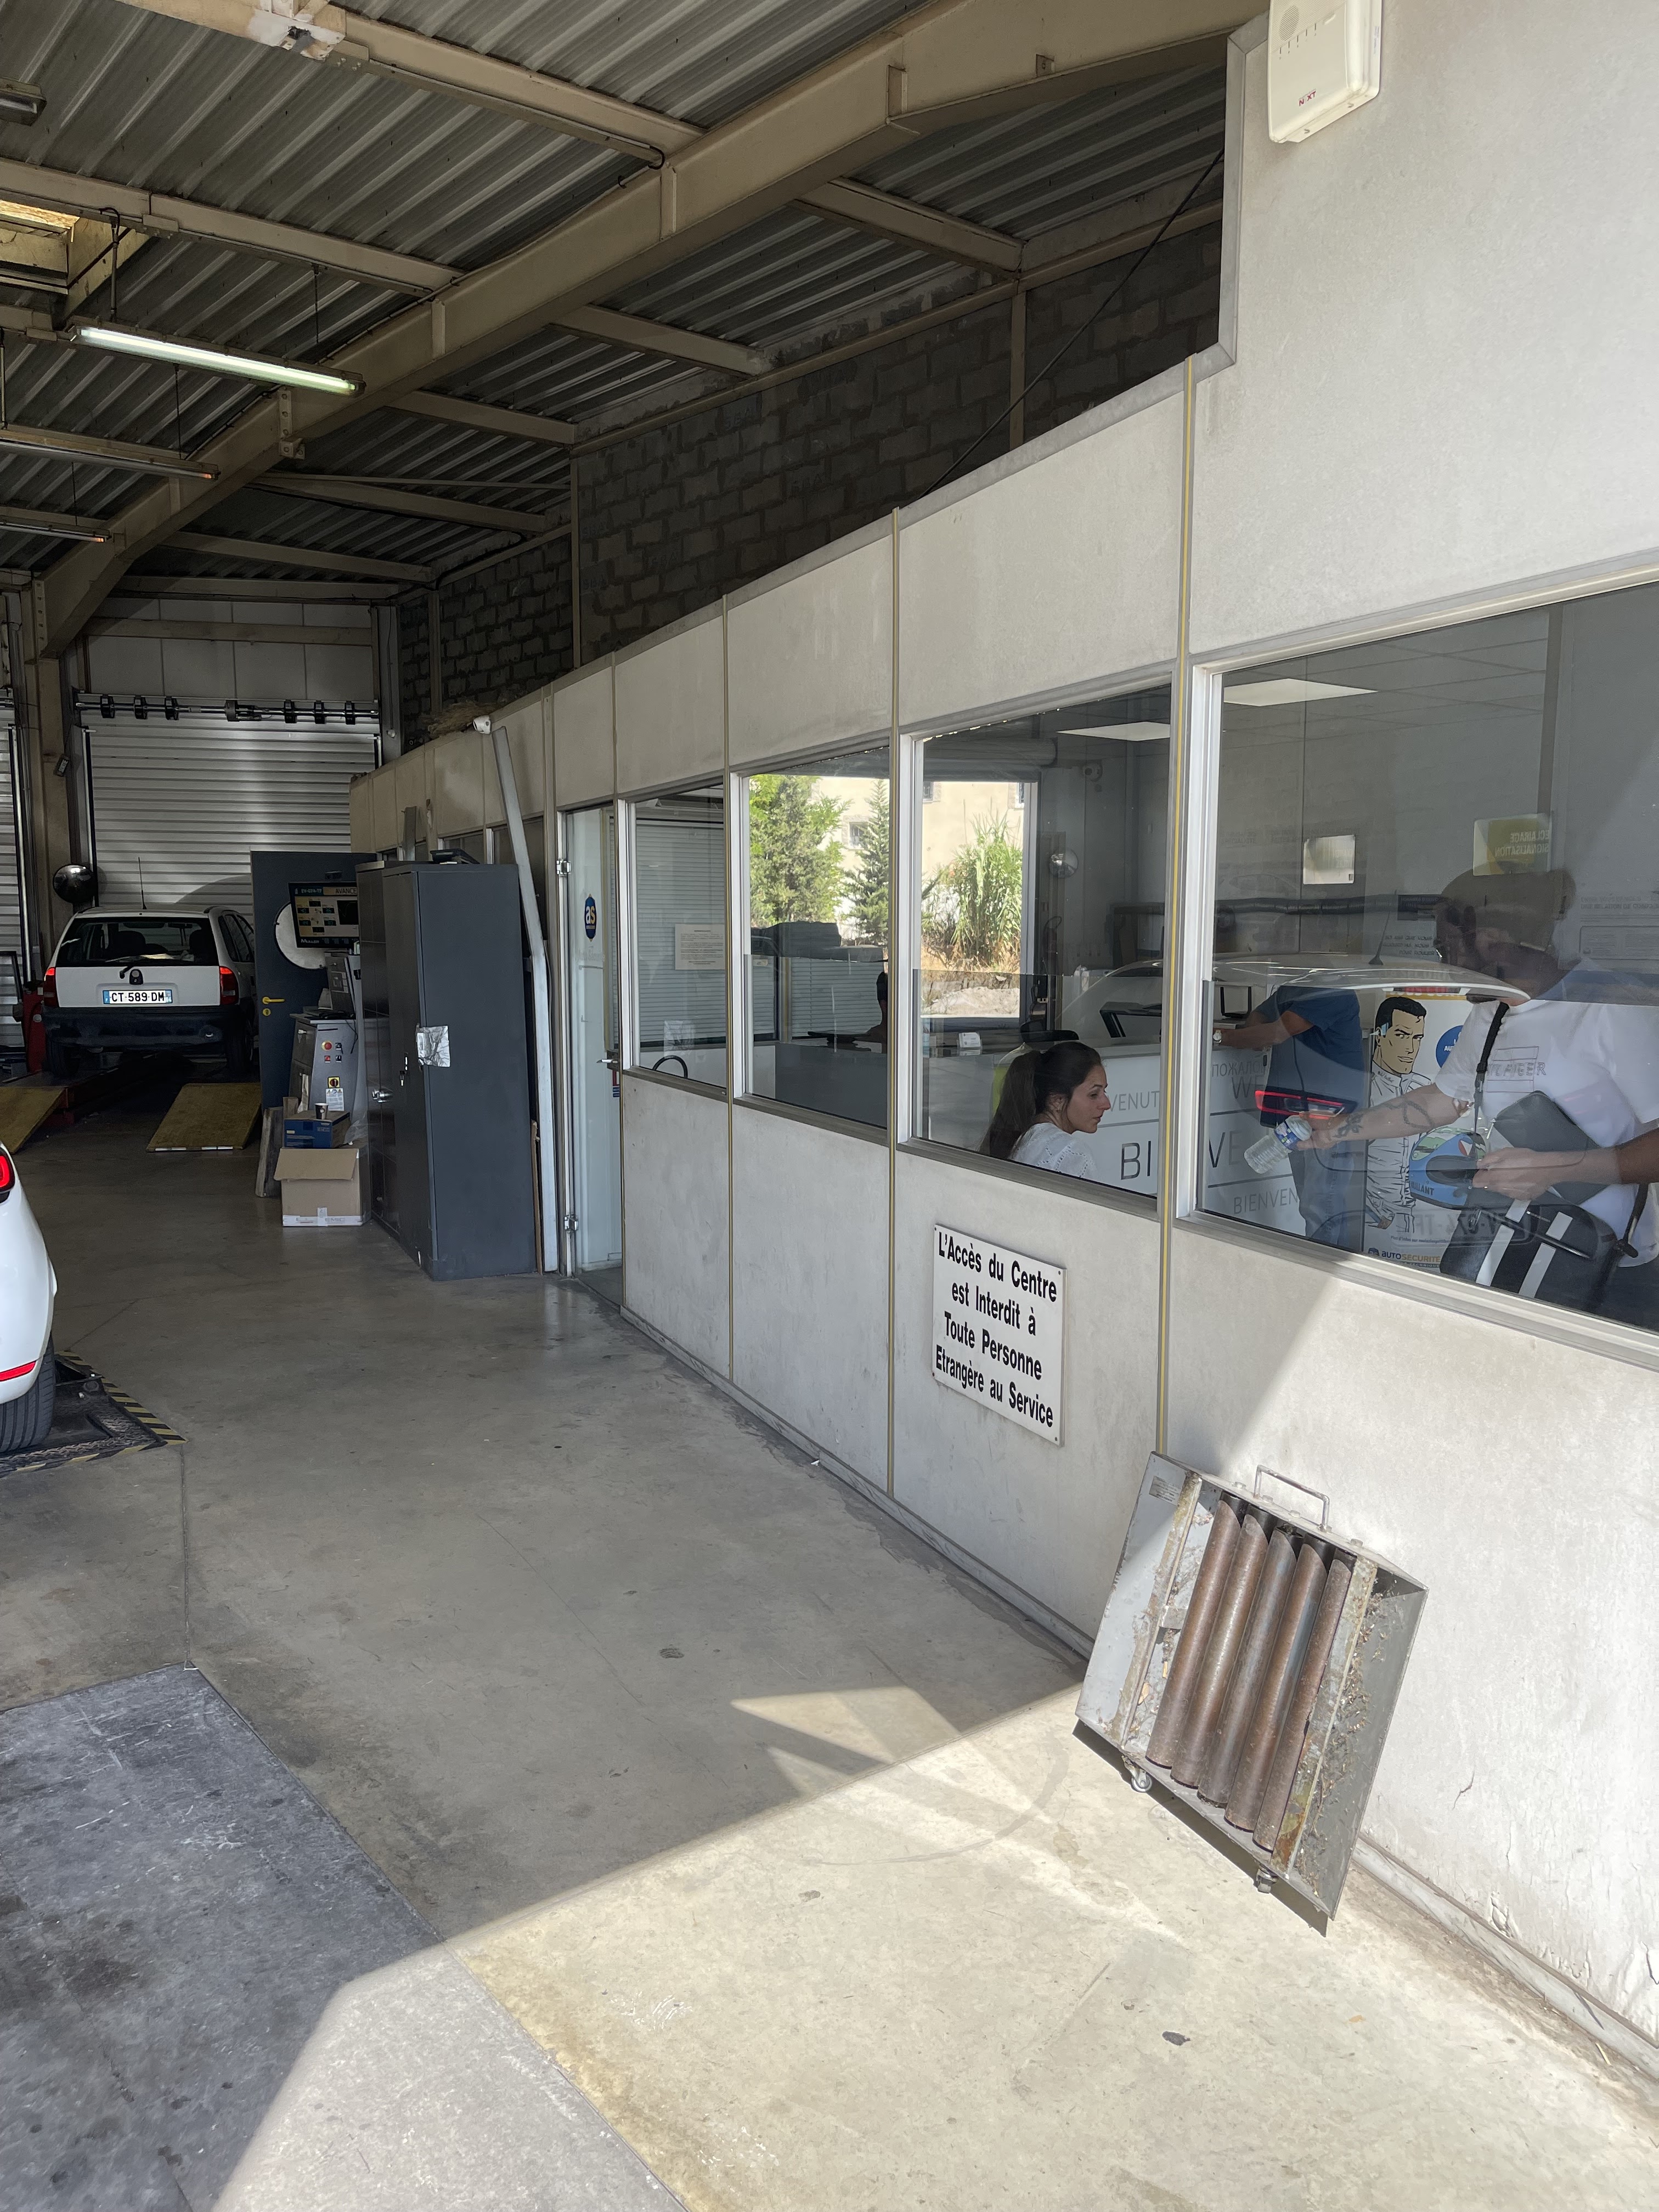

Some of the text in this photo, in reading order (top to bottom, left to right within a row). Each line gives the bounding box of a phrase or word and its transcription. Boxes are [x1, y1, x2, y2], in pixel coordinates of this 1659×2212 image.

[939, 1231, 1057, 1302] L'Accès du Centre
[952, 1282, 1036, 1336] est Interdit à
[944, 1310, 1042, 1380] Toute Personne
[936, 1344, 1053, 1427] Etrangère au Service
